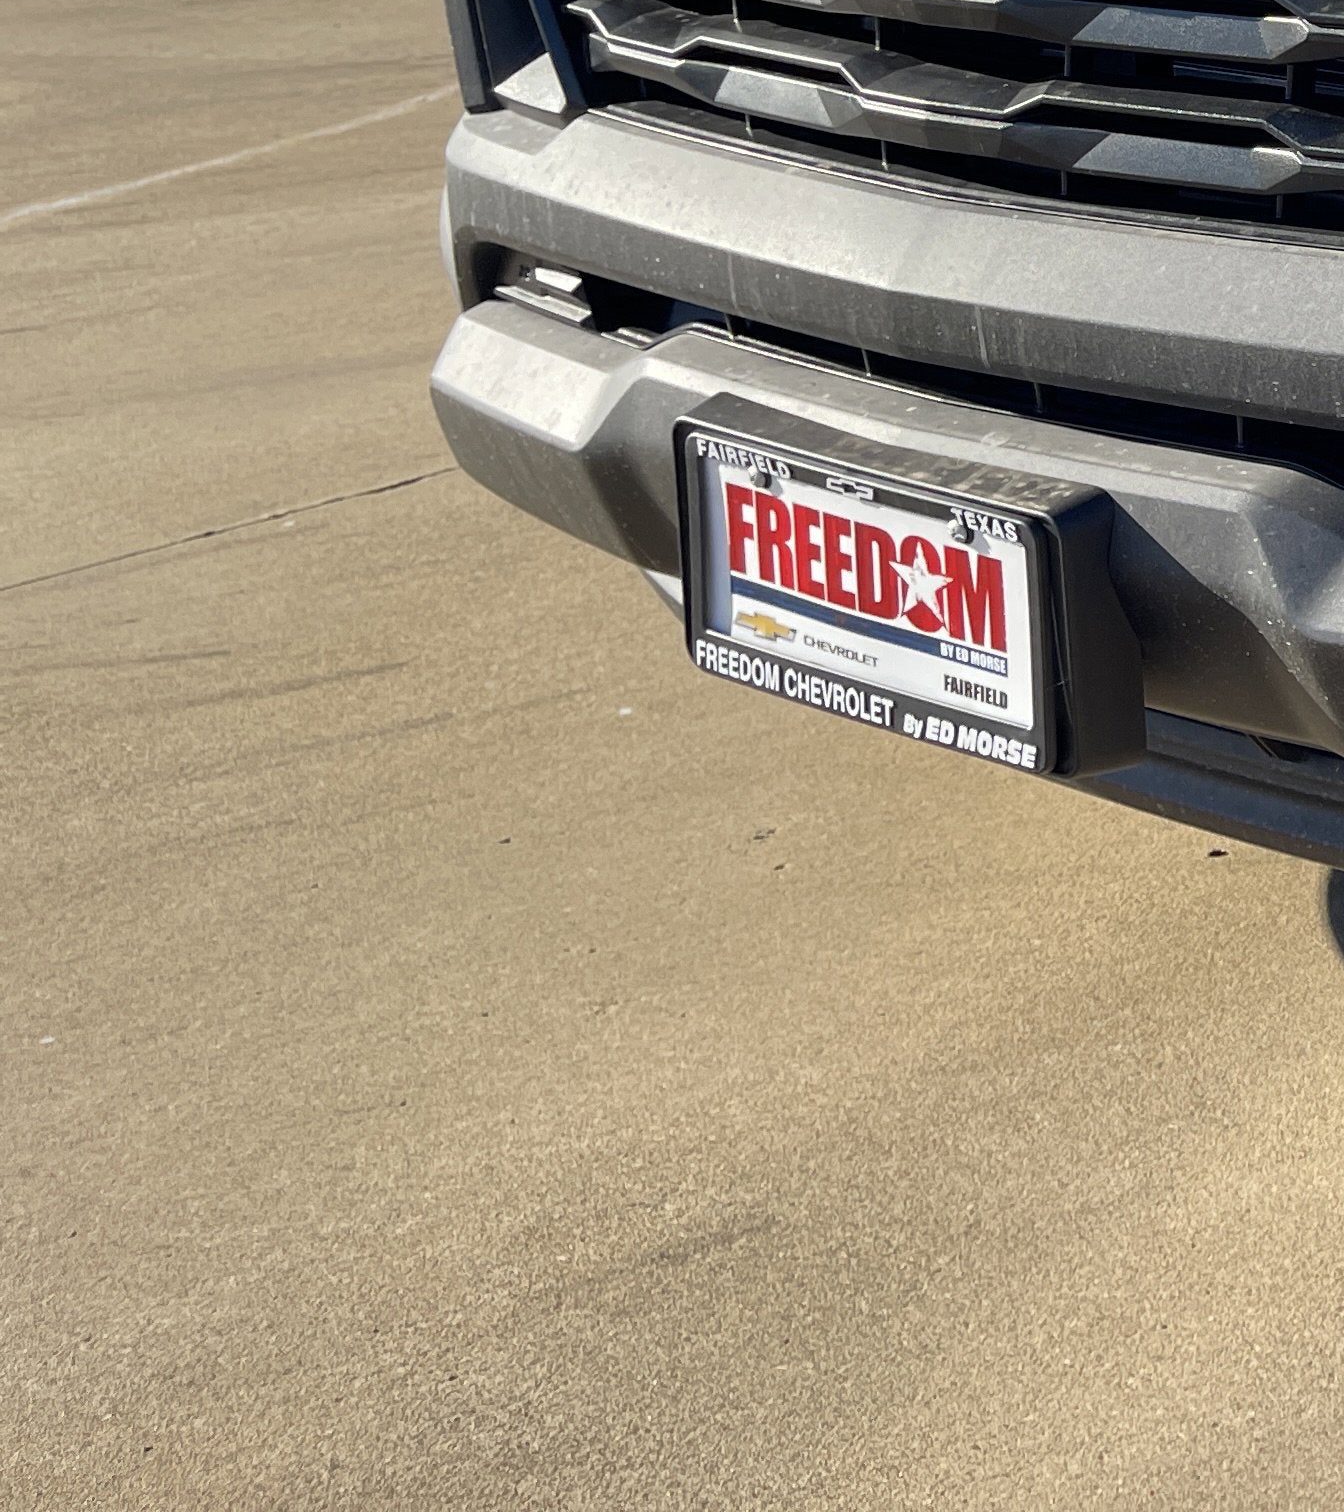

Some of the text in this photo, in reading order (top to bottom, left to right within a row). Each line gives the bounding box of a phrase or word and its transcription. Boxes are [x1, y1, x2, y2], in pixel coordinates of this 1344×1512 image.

[696, 438, 792, 480] FAIRFIELD
[950, 507, 1018, 543] TEXAS
[725, 482, 1007, 653] FREEDOM
[803, 634, 879, 668] CHEVROLET
[940, 642, 1007, 674] BY ED MORSE
[695, 638, 780, 692] FREEDOM
[783, 667, 895, 727] CHEVROLET
[925, 715, 955, 745] ED
[957, 724, 1038, 769] MORSE
[944, 674, 1007, 709] FAIRFIELD
